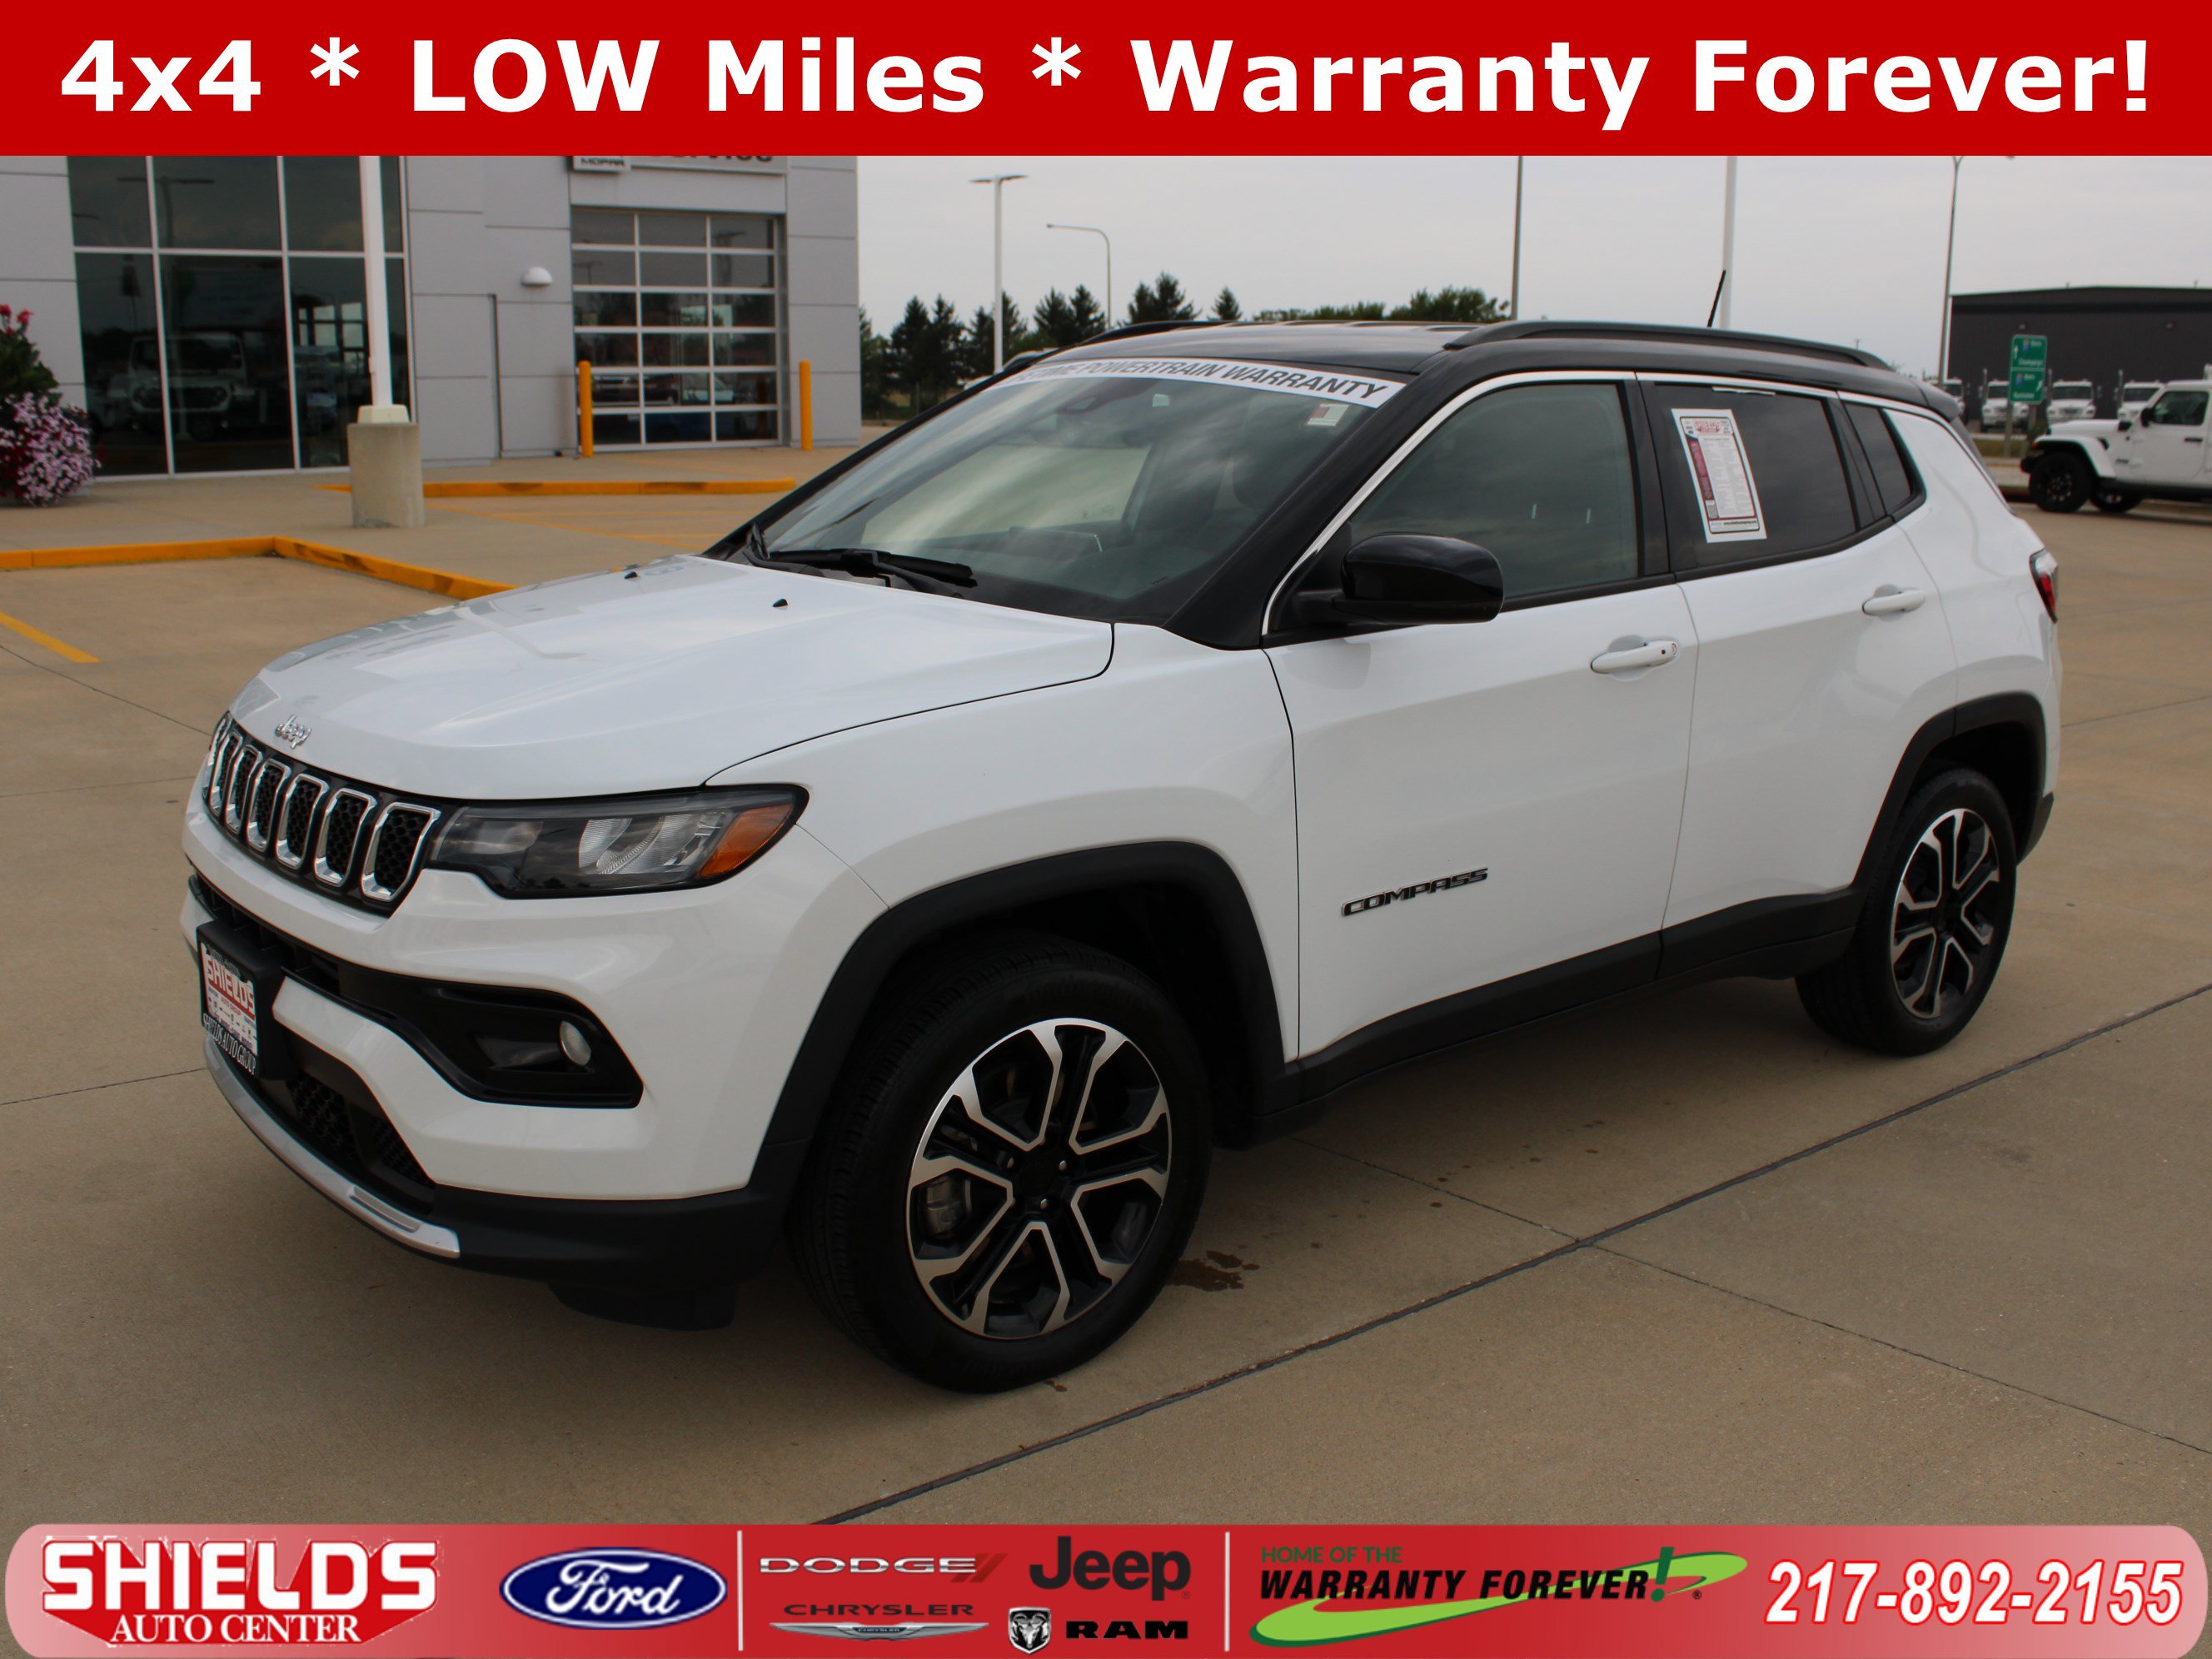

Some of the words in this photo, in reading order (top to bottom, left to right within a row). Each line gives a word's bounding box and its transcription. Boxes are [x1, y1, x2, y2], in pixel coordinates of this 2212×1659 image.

[1076, 360, 1226, 377] POWERTRAIN
[1221, 365, 1389, 400] WARRANTY
[274, 715, 312, 749] Jeep
[1341, 867, 1488, 917] COMPASS
[206, 958, 255, 1014] SHIELDS
[222, 1031, 238, 1059] AUTO
